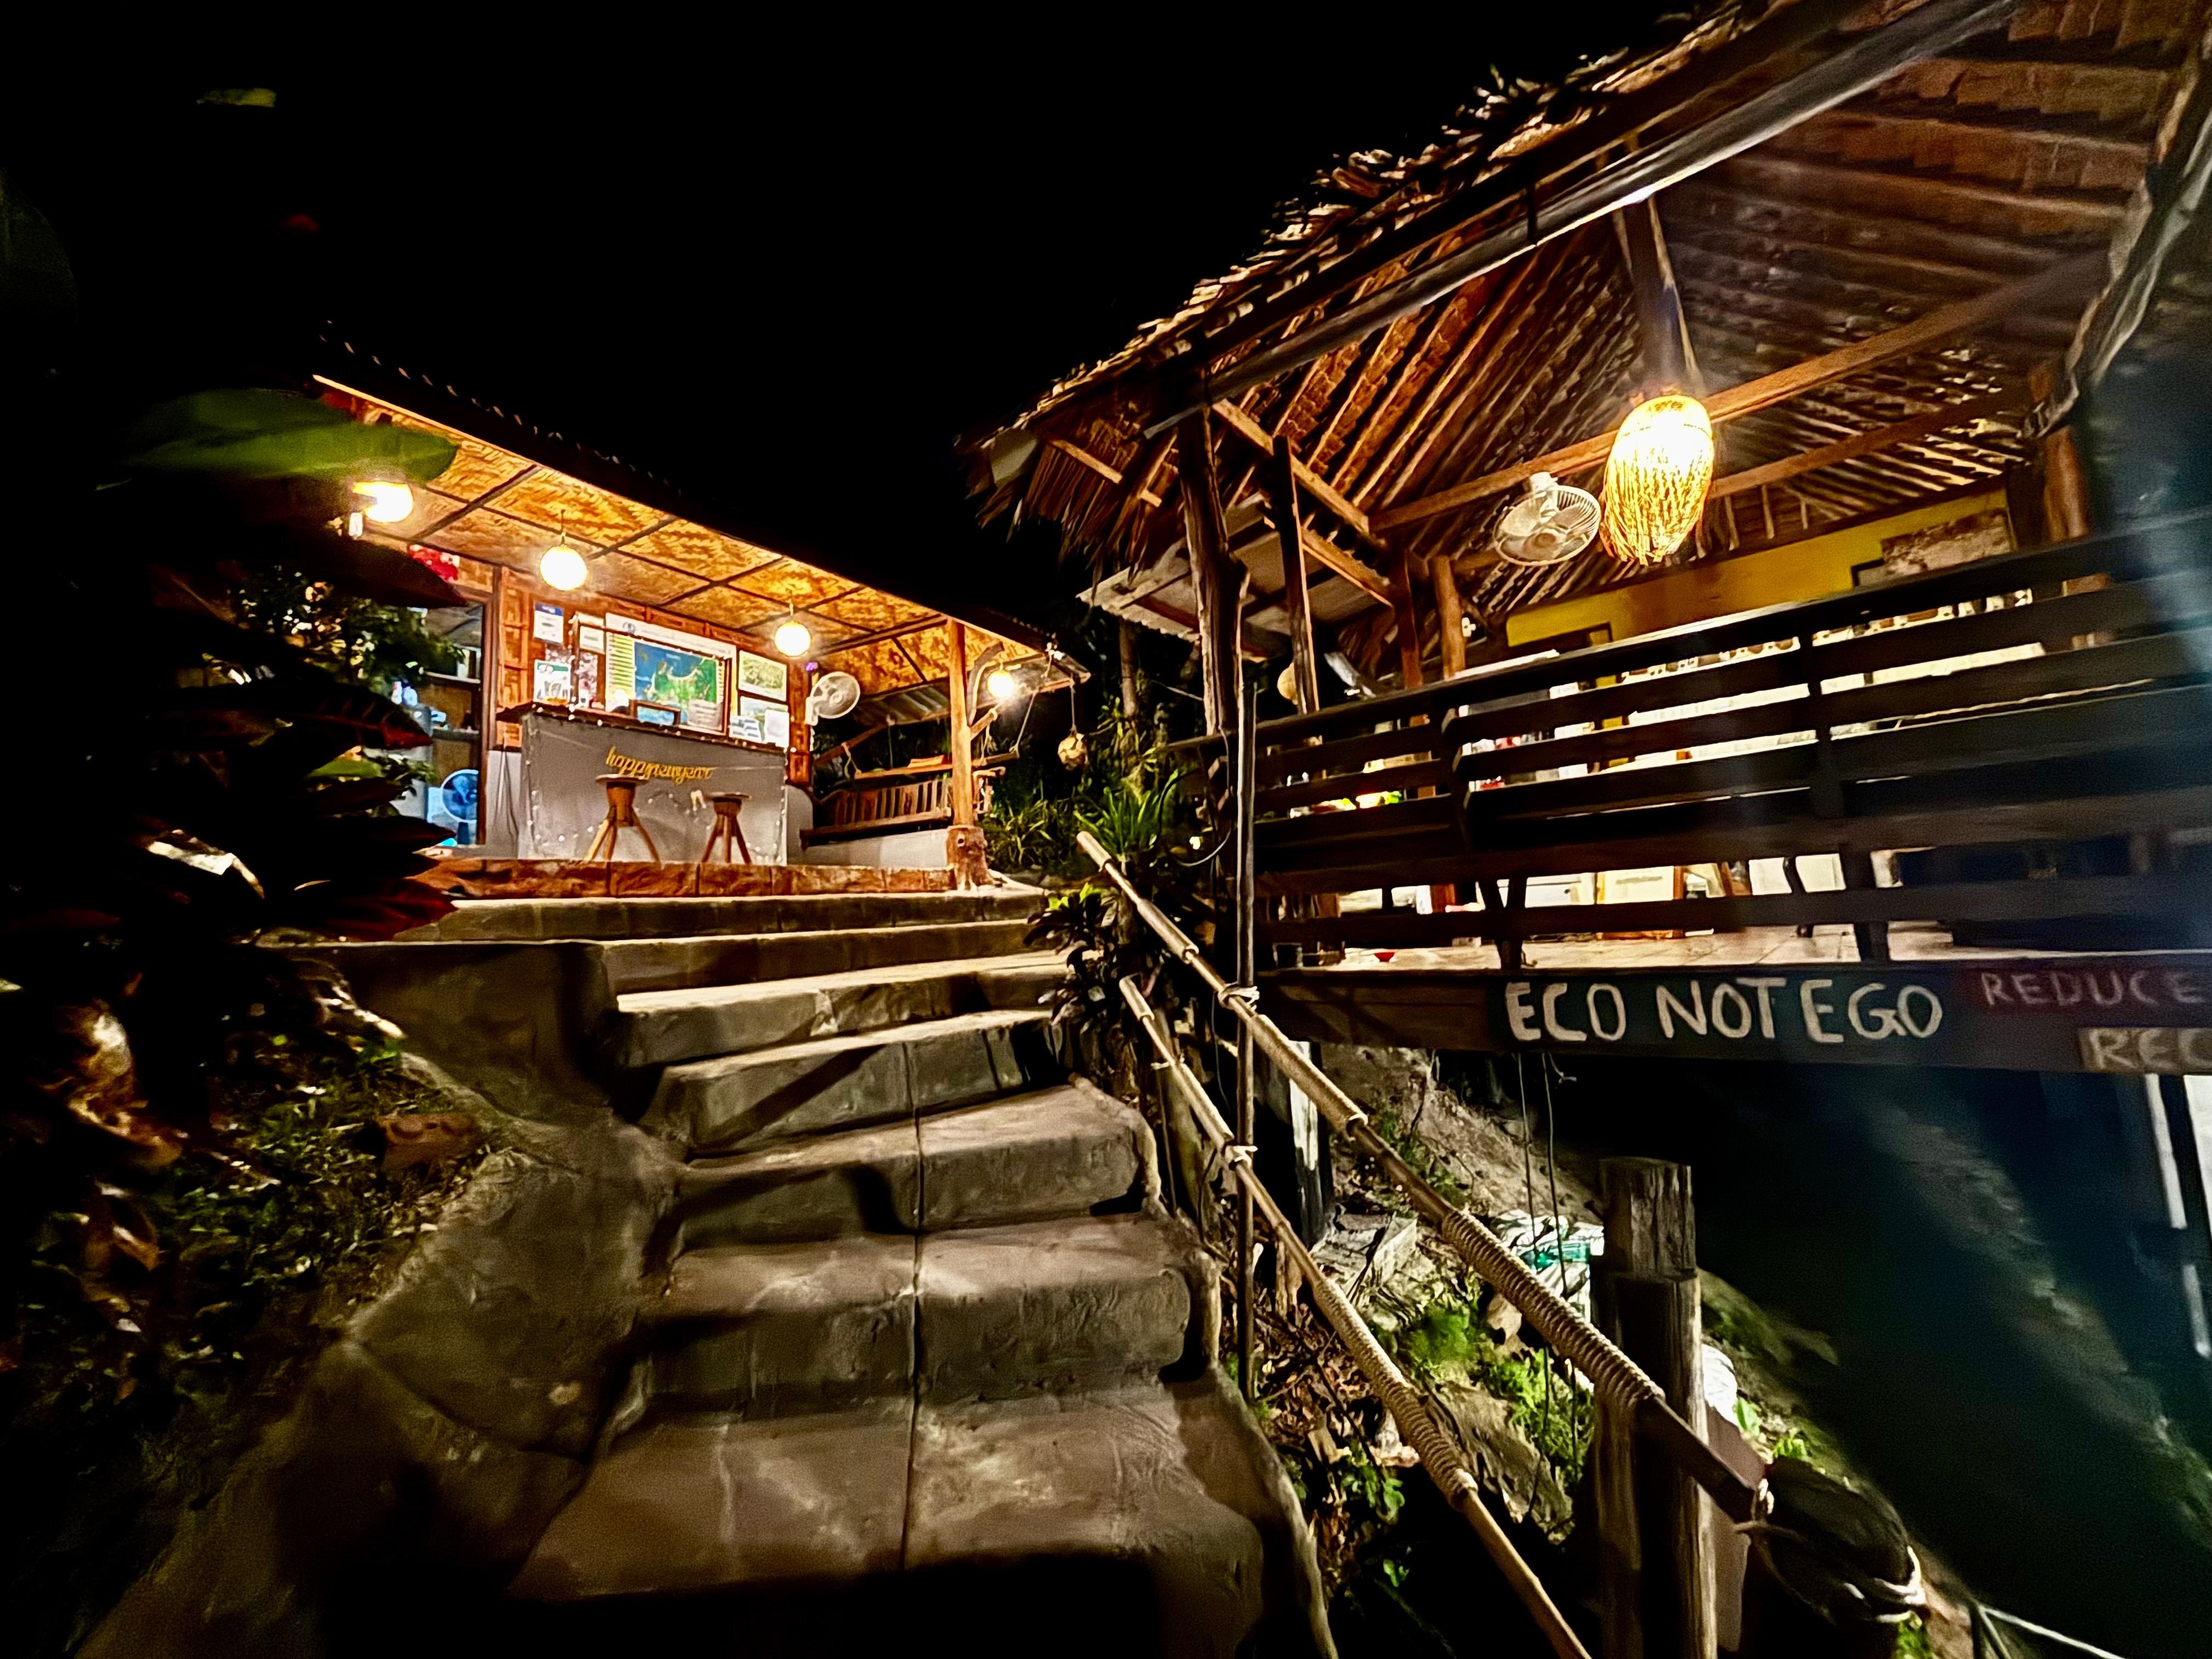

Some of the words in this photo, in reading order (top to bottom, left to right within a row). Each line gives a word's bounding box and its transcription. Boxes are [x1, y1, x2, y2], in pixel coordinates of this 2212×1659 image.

[1505, 981, 1627, 1042] ECO
[1655, 977, 1787, 1039] NOT
[1799, 979, 1943, 1043] EGO
[1980, 970, 2205, 1007] REDUCE
